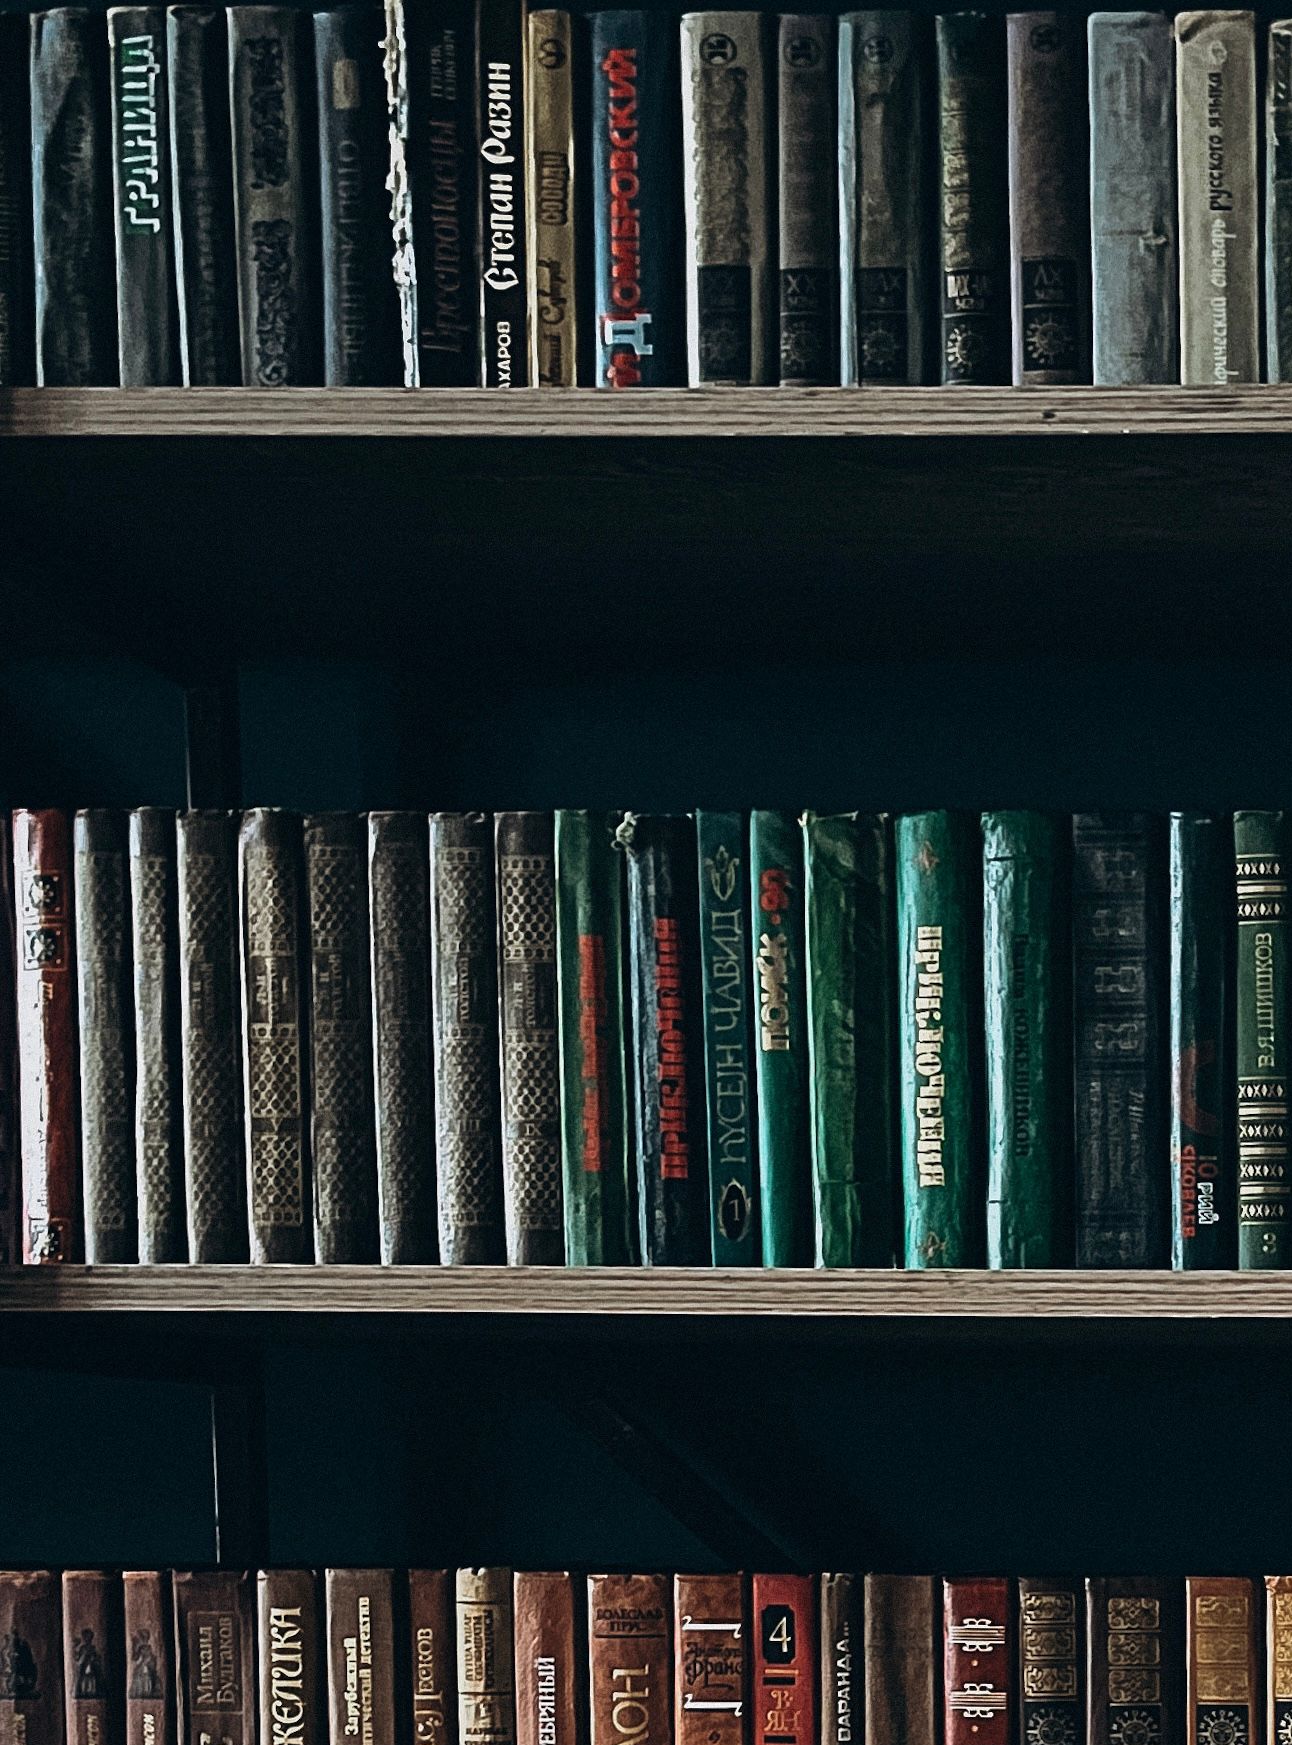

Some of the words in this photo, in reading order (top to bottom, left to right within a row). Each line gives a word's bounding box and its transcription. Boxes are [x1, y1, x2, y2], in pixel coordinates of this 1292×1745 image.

[122, 36, 160, 232] ГРАНИЦА
[481, 63, 515, 164] Разин
[1209, 73, 1222, 127] языка
[601, 49, 652, 355] ДОМБРОВСКИЙ
[1209, 136, 1232, 211] русского
[483, 173, 519, 290] Степан
[1211, 219, 1236, 287] словарь
[1211, 298, 1238, 384] фический
[1255, 933, 1273, 1029] ШИШКОВ
[1263, 1233, 1277, 1253] 3
[197, 1627, 214, 1703] Михаил
[217, 1617, 235, 1703] Булгаков
[344, 1638, 360, 1735] Зарубежный
